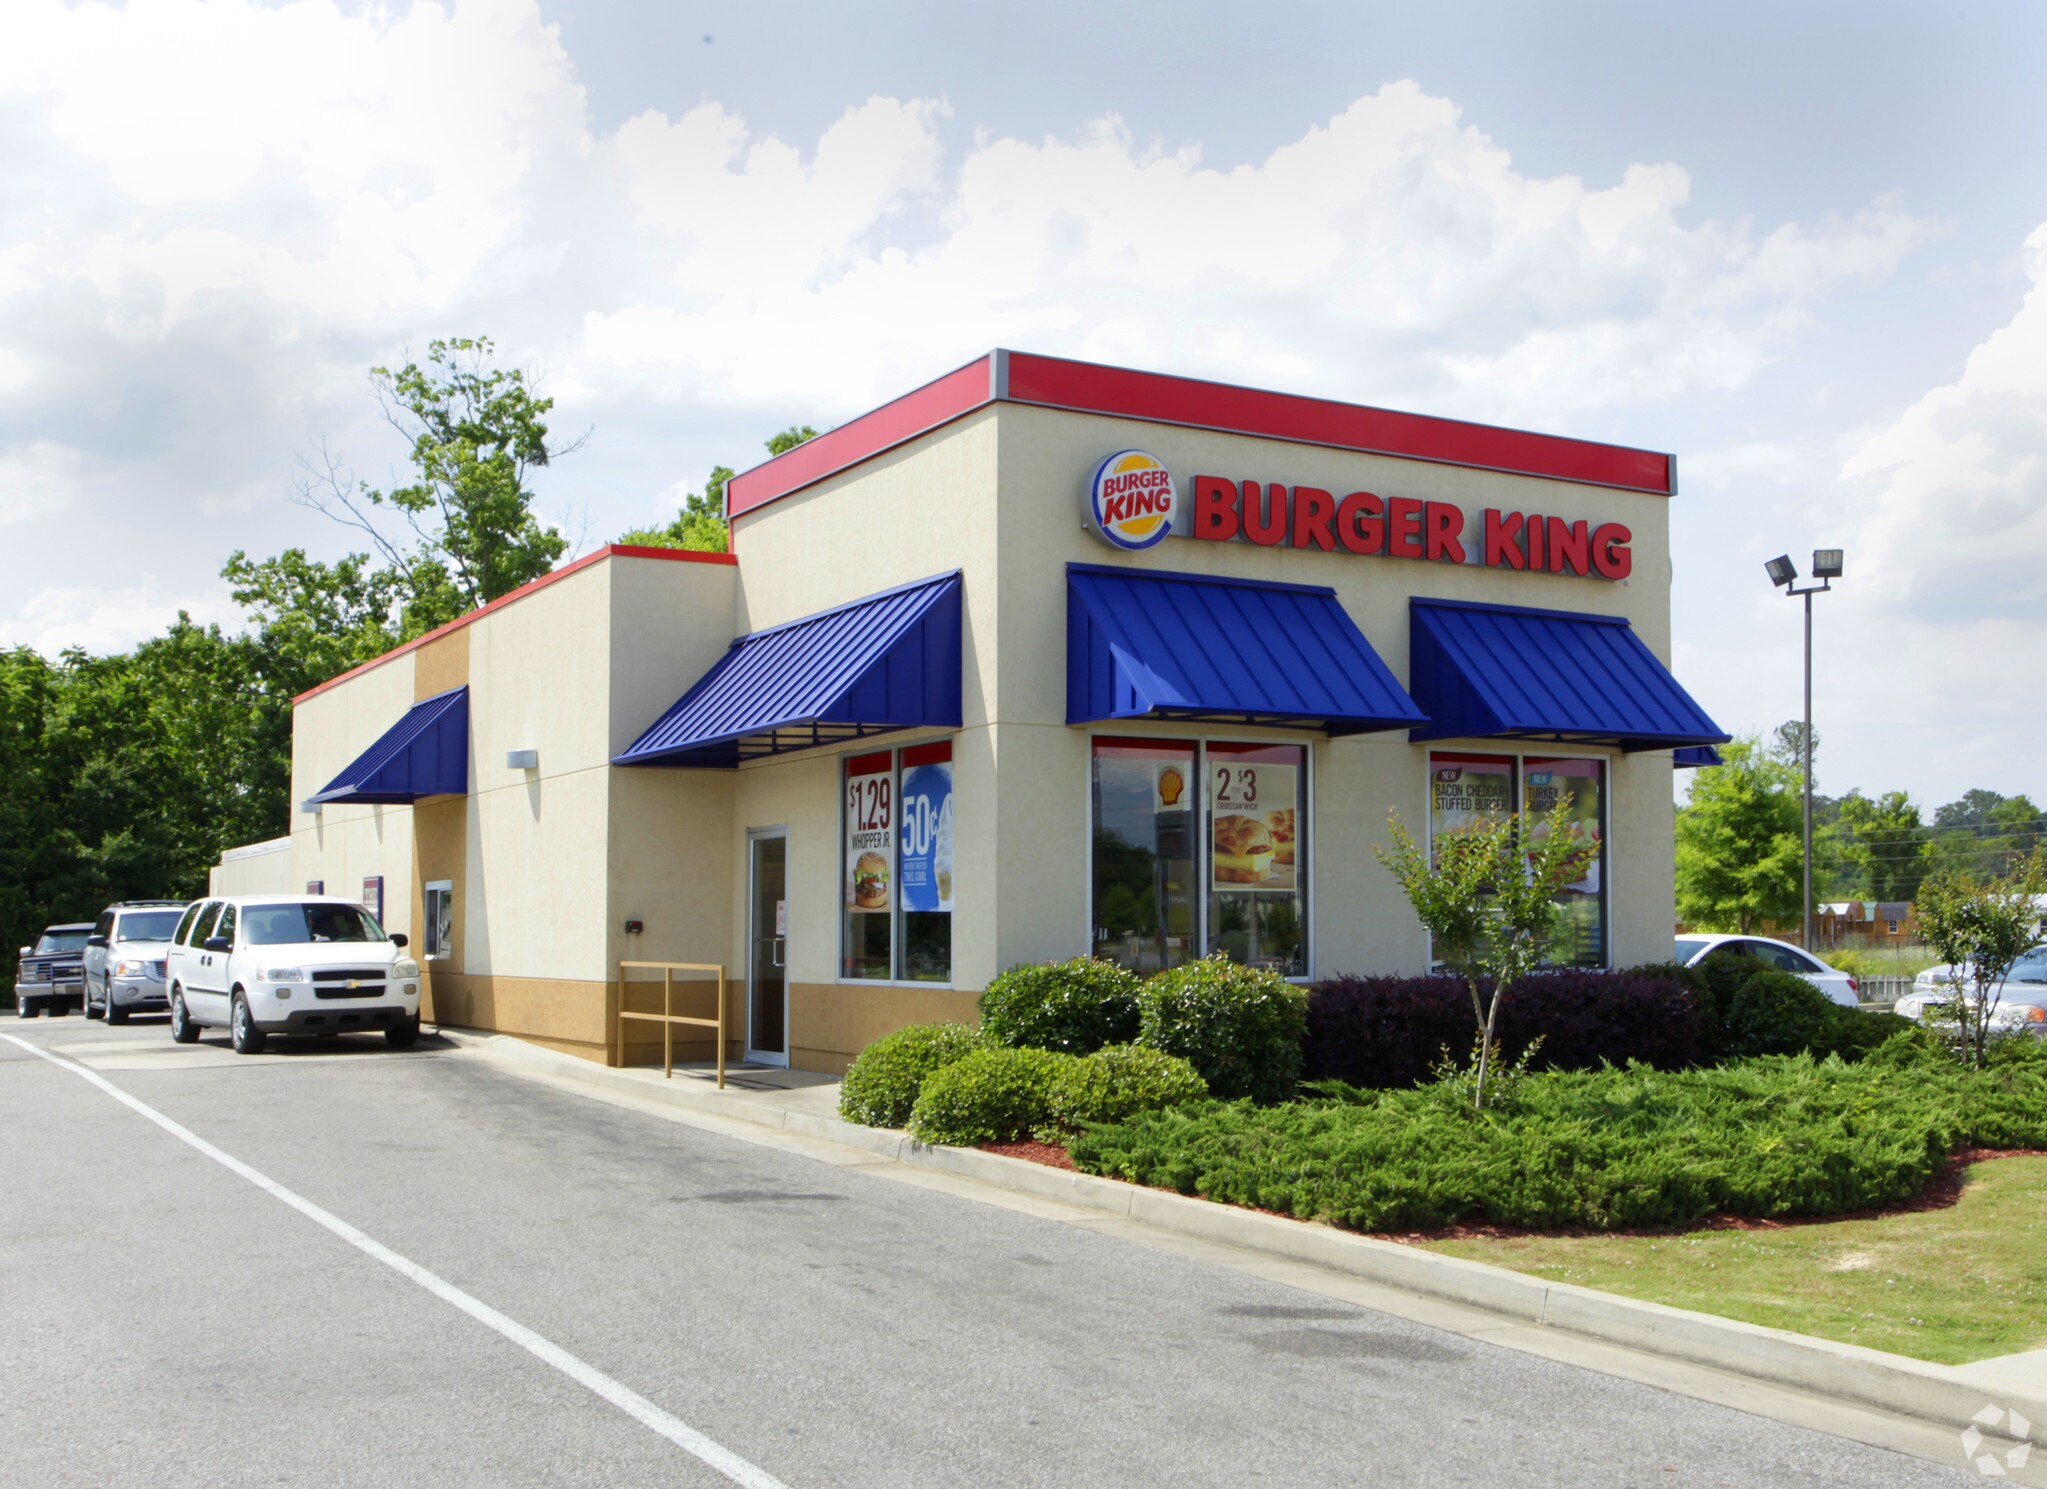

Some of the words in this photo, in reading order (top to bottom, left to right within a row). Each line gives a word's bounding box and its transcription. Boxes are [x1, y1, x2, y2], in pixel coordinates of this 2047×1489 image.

[1103, 470, 1170, 498] BURGER
[1103, 487, 1171, 526] KING
[1192, 474, 1467, 564] BURGER
[1482, 507, 1633, 581] KING
[1217, 768, 1231, 801] 2
[1238, 769, 1257, 802] $3
[1442, 770, 1456, 780] NEW
[1533, 774, 1547, 784] NEW
[1435, 784, 1462, 796] BACON
[1466, 784, 1504, 798] CHEDDAR
[1528, 787, 1558, 799] TURKEY
[850, 778, 890, 830] $1.29
[1435, 797, 1472, 811] STUFFED
[902, 794, 937, 856] 50¢
[852, 832, 881, 849] WHOPPER
